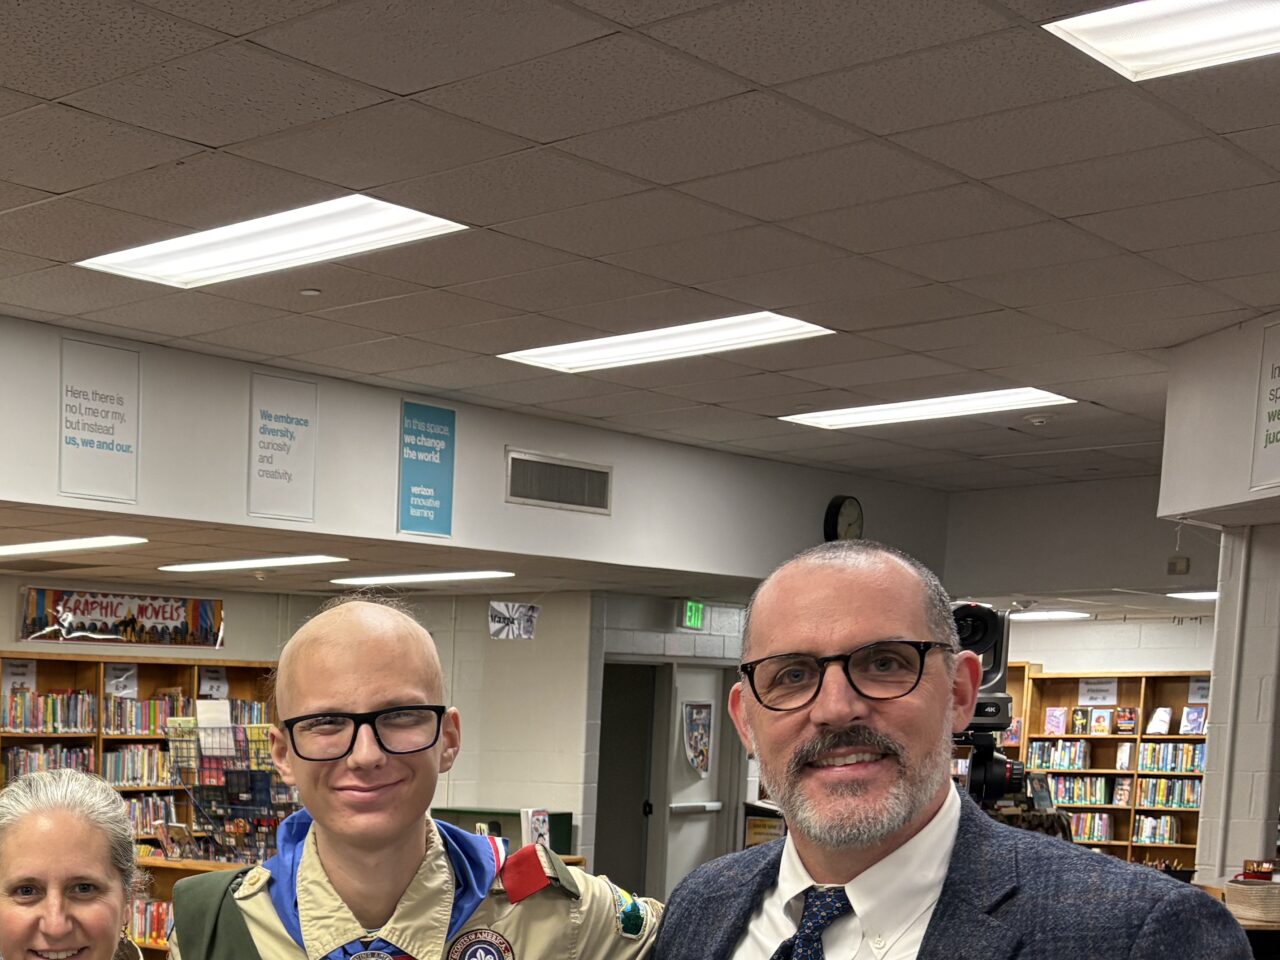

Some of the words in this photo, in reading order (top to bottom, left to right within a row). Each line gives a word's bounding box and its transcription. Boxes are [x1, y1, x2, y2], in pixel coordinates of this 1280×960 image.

[65, 384, 90, 402] Here,
[92, 389, 115, 405] there
[116, 393, 124, 406] is
[65, 403, 77, 414] no
[85, 406, 99, 418] me
[100, 409, 110, 419] or
[111, 411, 126, 424] my,
[259, 408, 273, 422] We
[274, 413, 309, 427] embrace
[65, 417, 80, 431] but
[81, 419, 114, 436] instead
[404, 416, 411, 428] In
[412, 418, 426, 431] this
[259, 424, 296, 442] diversity,
[65, 436, 80, 448] us,
[80, 438, 95, 448] we
[96, 440, 114, 451] and
[115, 443, 133, 454] our.
[258, 440, 291, 455] curiosity
[404, 434, 416, 445] we
[417, 434, 445, 451] change
[258, 454, 273, 465] and
[403, 447, 417, 459] the
[411, 485, 434, 496] verizon
[409, 506, 434, 520] learning
[63, 598, 124, 618] GRAPHIC
[136, 603, 181, 621] NOVELS
[687, 601, 704, 628] EXIT
[452, 936, 470, 959] SCOUTS
[477, 931, 506, 950] AMERICA
